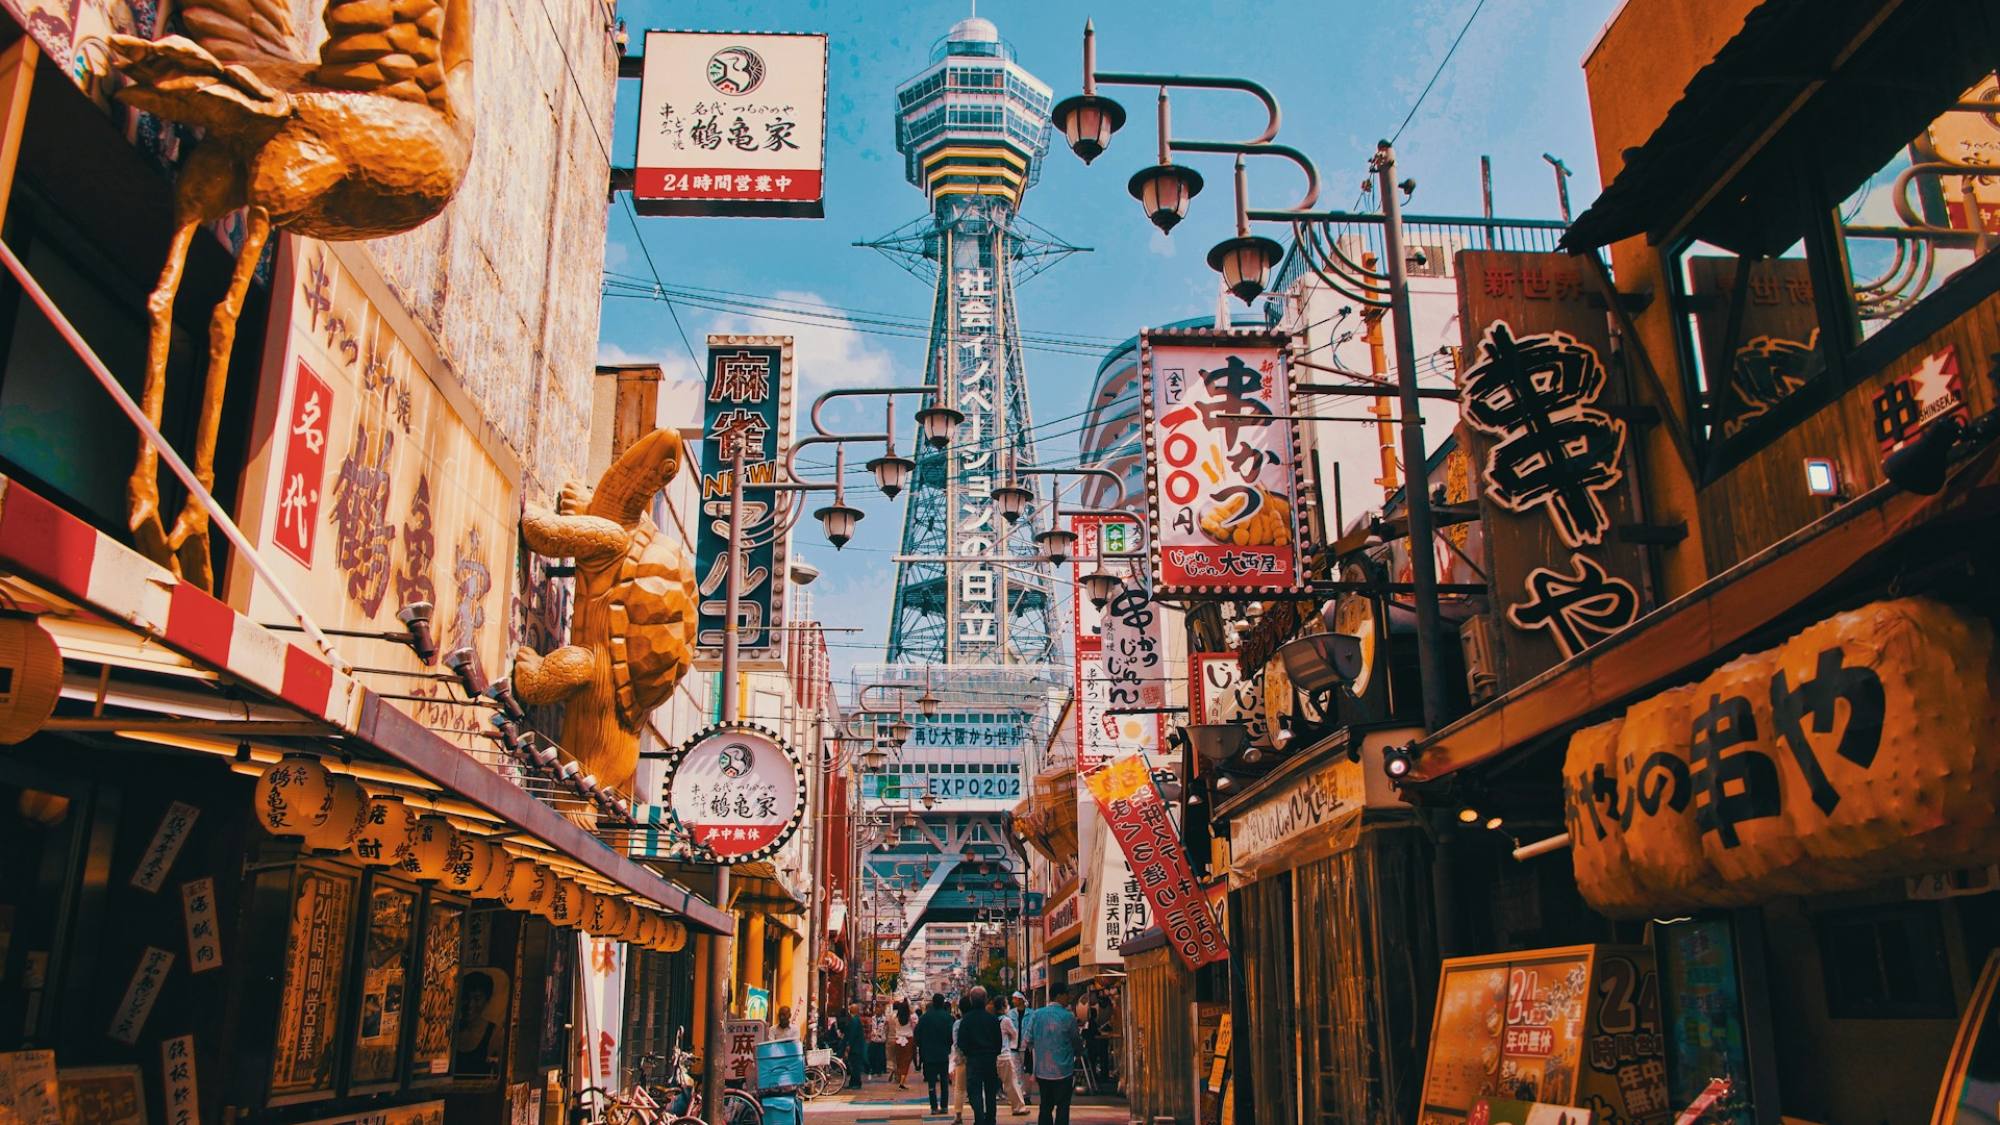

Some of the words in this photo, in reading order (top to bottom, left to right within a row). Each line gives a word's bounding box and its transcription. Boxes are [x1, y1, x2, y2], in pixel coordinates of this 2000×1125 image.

[690, 115, 801, 152] 鶴亀家
[663, 172, 793, 193] 24時間営業中
[1484, 267, 1584, 300] 新世界
[1166, 371, 1184, 402] 全て
[705, 351, 771, 462] 麻雀
[1919, 388, 1961, 423] SHINSEKA
[958, 269, 996, 643] 社会イノベーションの日立
[1194, 354, 1281, 528] 串かつ
[281, 391, 325, 550] 名代
[330, 423, 492, 690] 鶴亀家
[1218, 550, 1284, 577] 大西屋
[915, 727, 1022, 747] 再び大阪から世界
[266, 766, 293, 828] 鶴亀家
[929, 778, 1021, 795] EXPO202
[710, 792, 778, 819] 鶴亀家
[706, 828, 760, 840] 年中無休
[1106, 893, 1120, 951] 通天閣店
[297, 896, 332, 1062] 24時間営業
[1506, 1029, 1552, 1054] 年中無休
